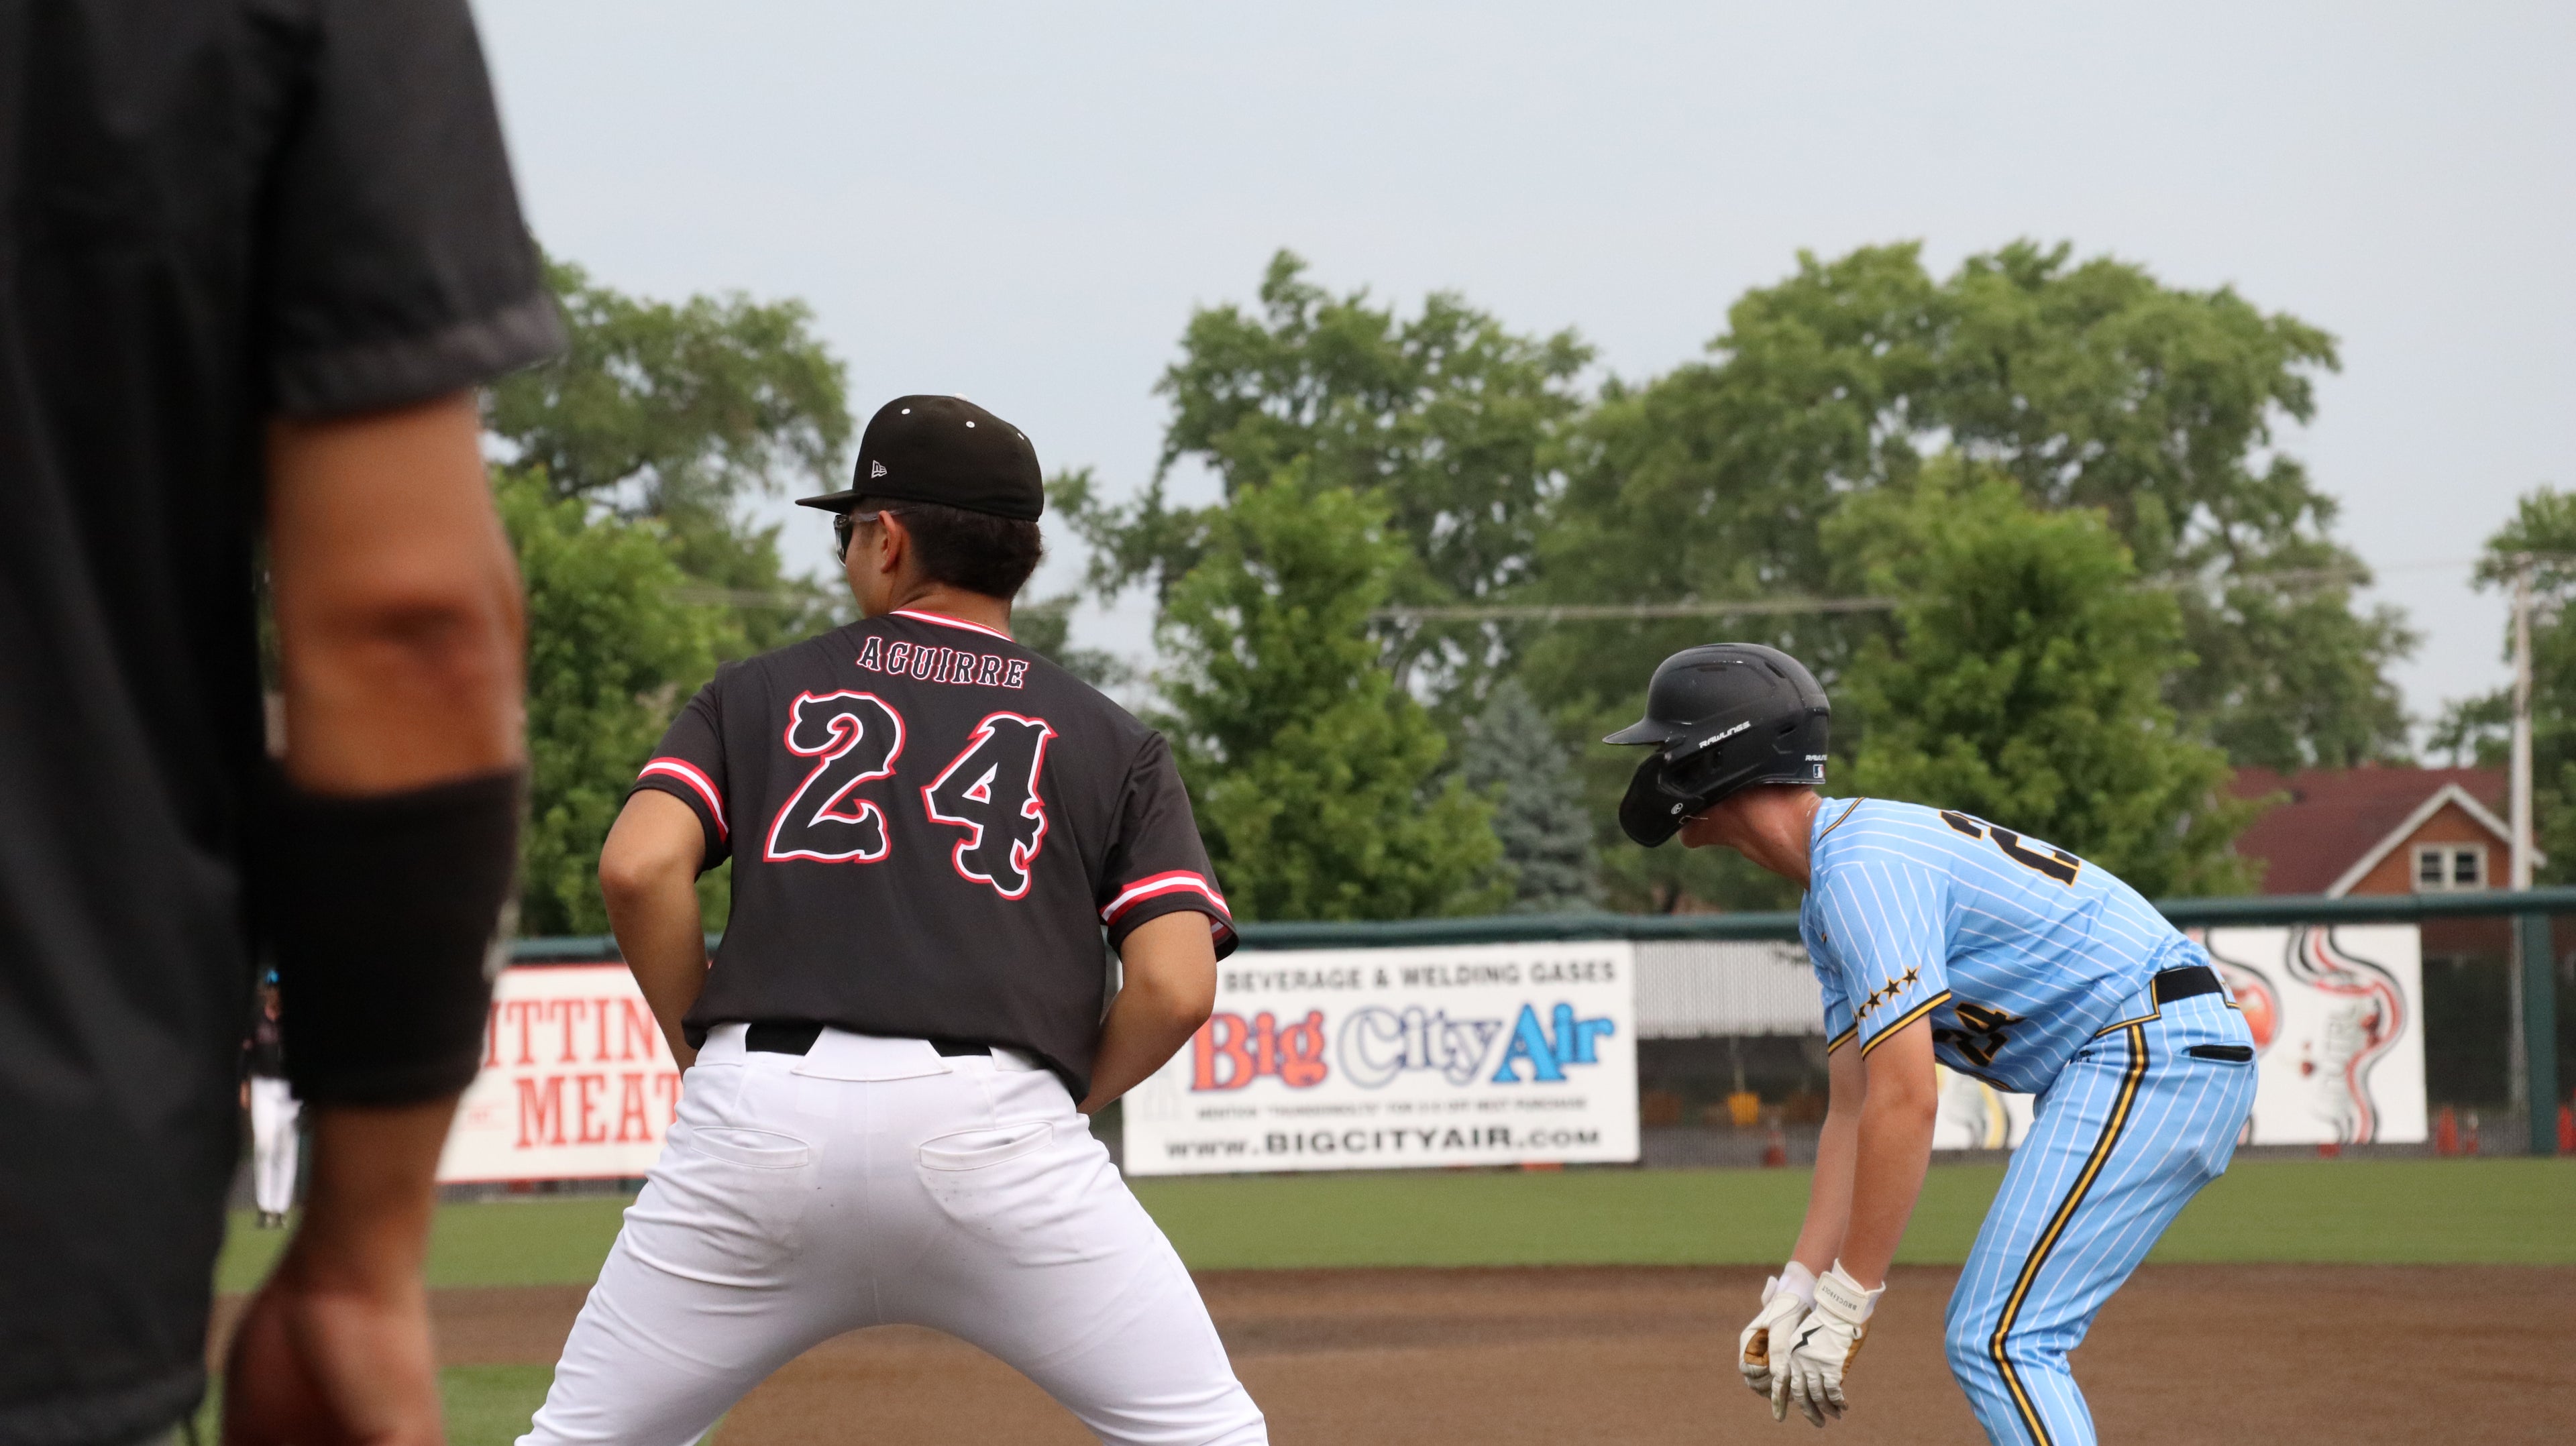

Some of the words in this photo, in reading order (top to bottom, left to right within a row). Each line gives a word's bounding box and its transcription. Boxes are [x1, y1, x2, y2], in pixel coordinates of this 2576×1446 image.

[857, 636, 1030, 689] AGUIRRE
[1699, 721, 1751, 748] RAWLINGS
[763, 689, 1059, 900] 24
[1224, 968, 1363, 992] BEVERAGE
[1374, 968, 1390, 989] &
[1401, 964, 1520, 989] WELDING
[1530, 960, 1614, 985] GASES
[1189, 1009, 1329, 1093] Big
[1338, 1004, 1503, 1088] City
[1491, 1001, 1616, 1084] Air
[1933, 1001, 2027, 1067] 24
